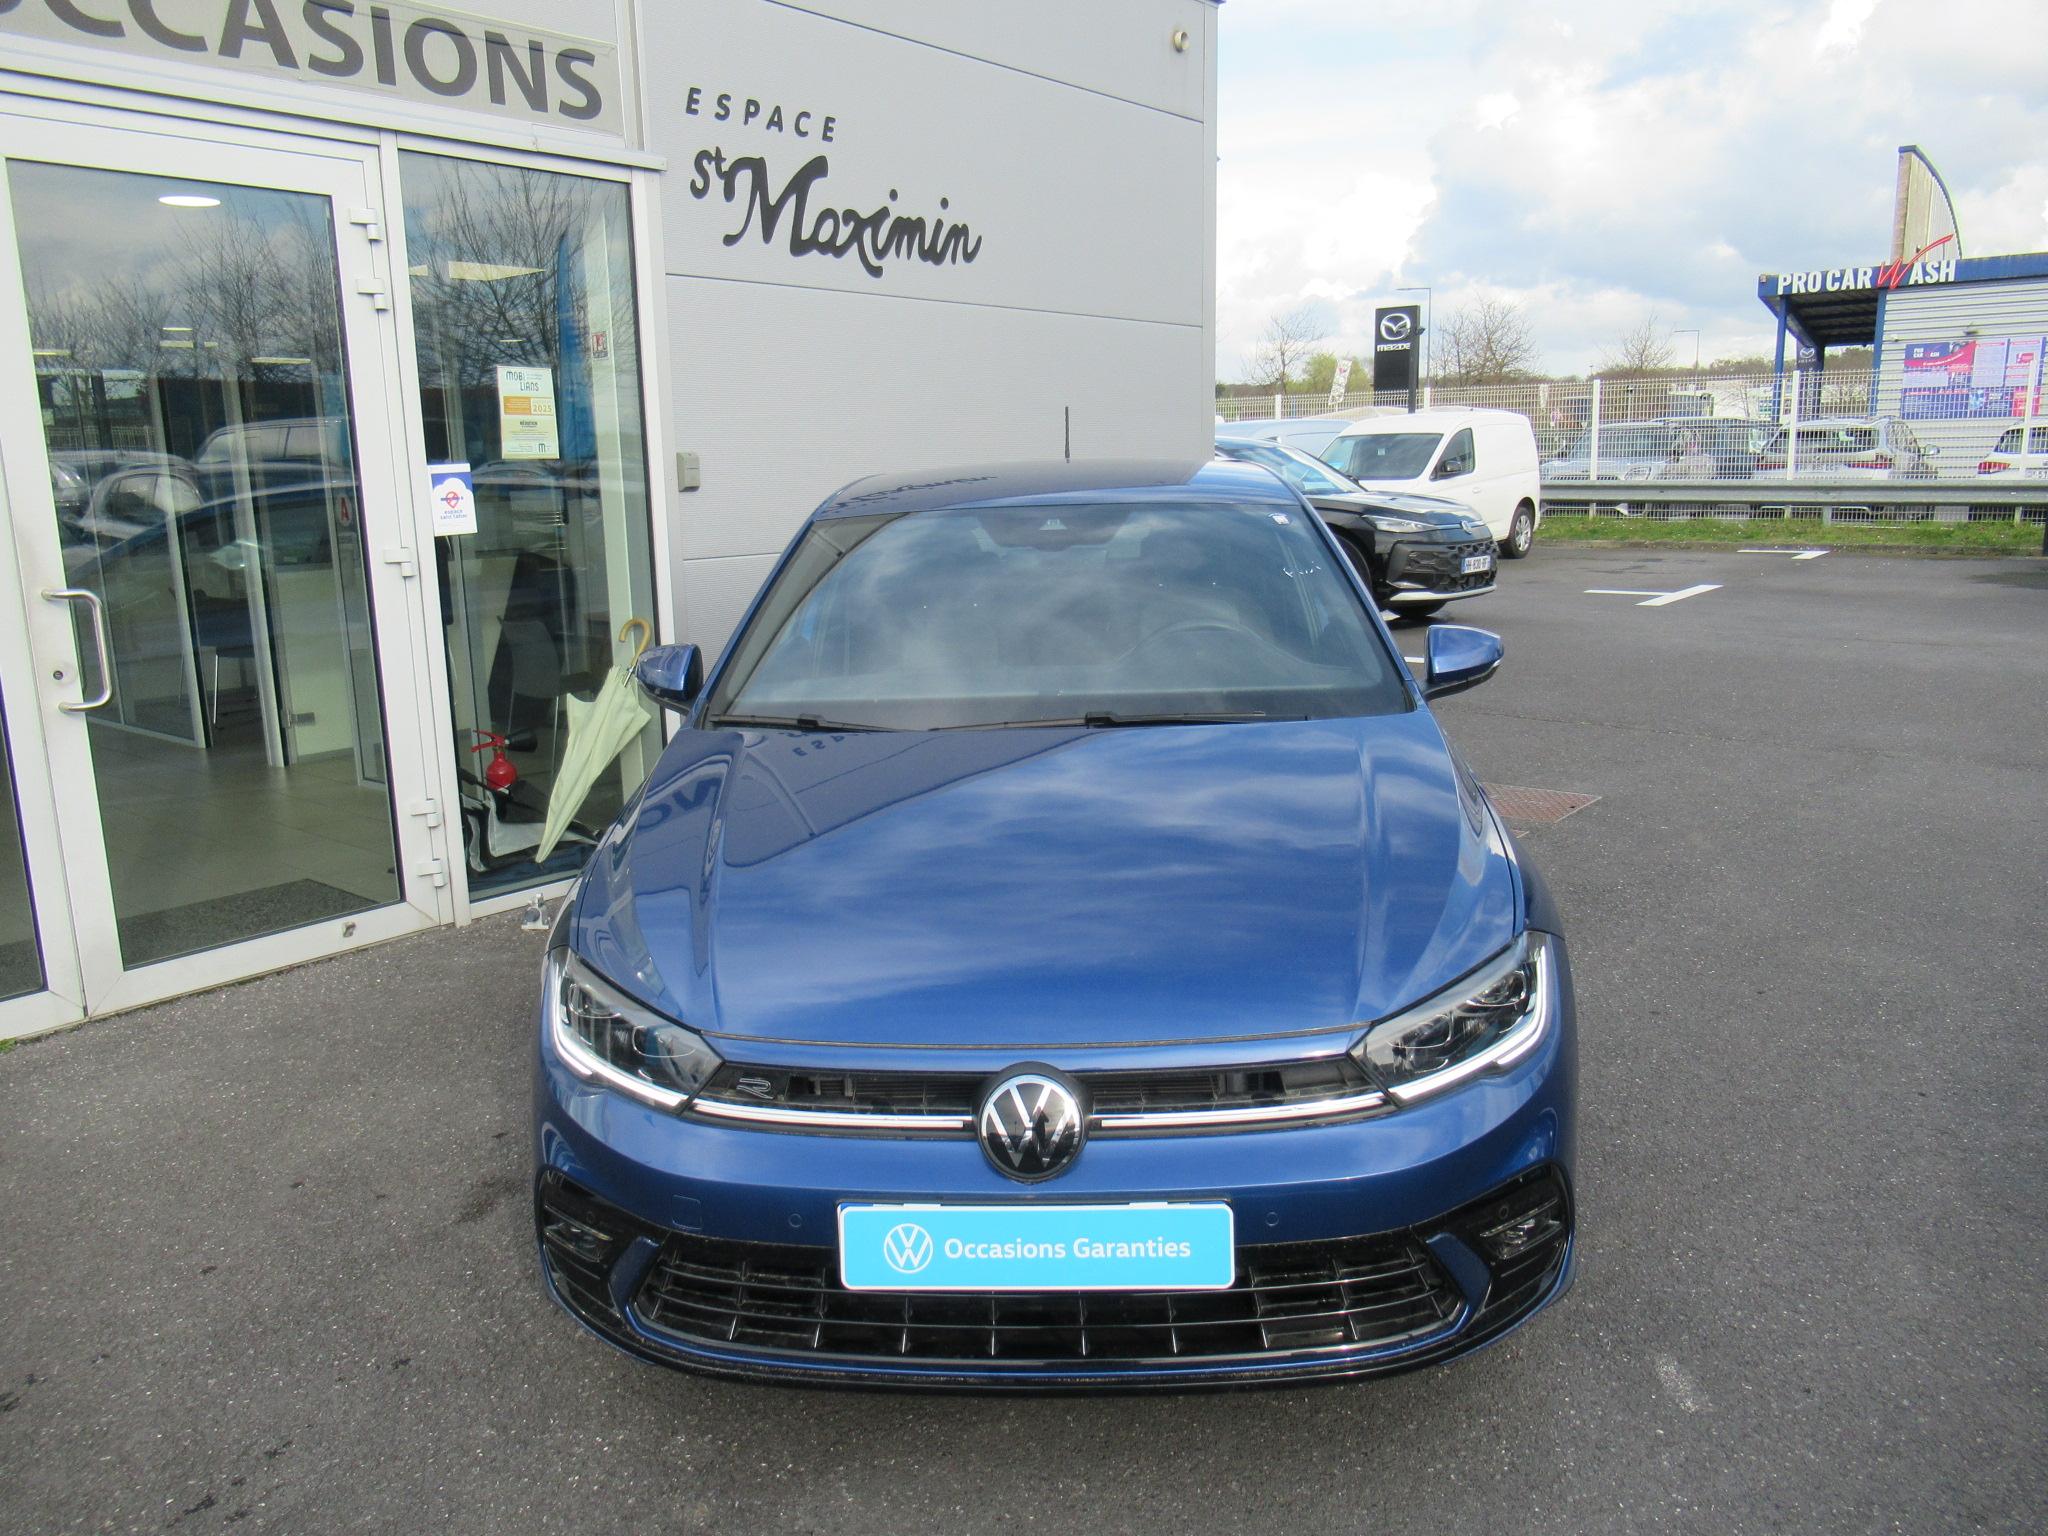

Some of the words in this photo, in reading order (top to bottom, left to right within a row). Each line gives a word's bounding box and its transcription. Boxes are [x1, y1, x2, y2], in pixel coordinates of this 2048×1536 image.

[0, 0, 602, 120] CASIONS
[685, 86, 837, 142] ESPACE
[722, 155, 982, 279] Maximin
[1777, 271, 1822, 296] PRO
[1826, 267, 1873, 292] CAR
[944, 1237, 1066, 1259] Occasions
[1073, 1236, 1191, 1259] Garanties
